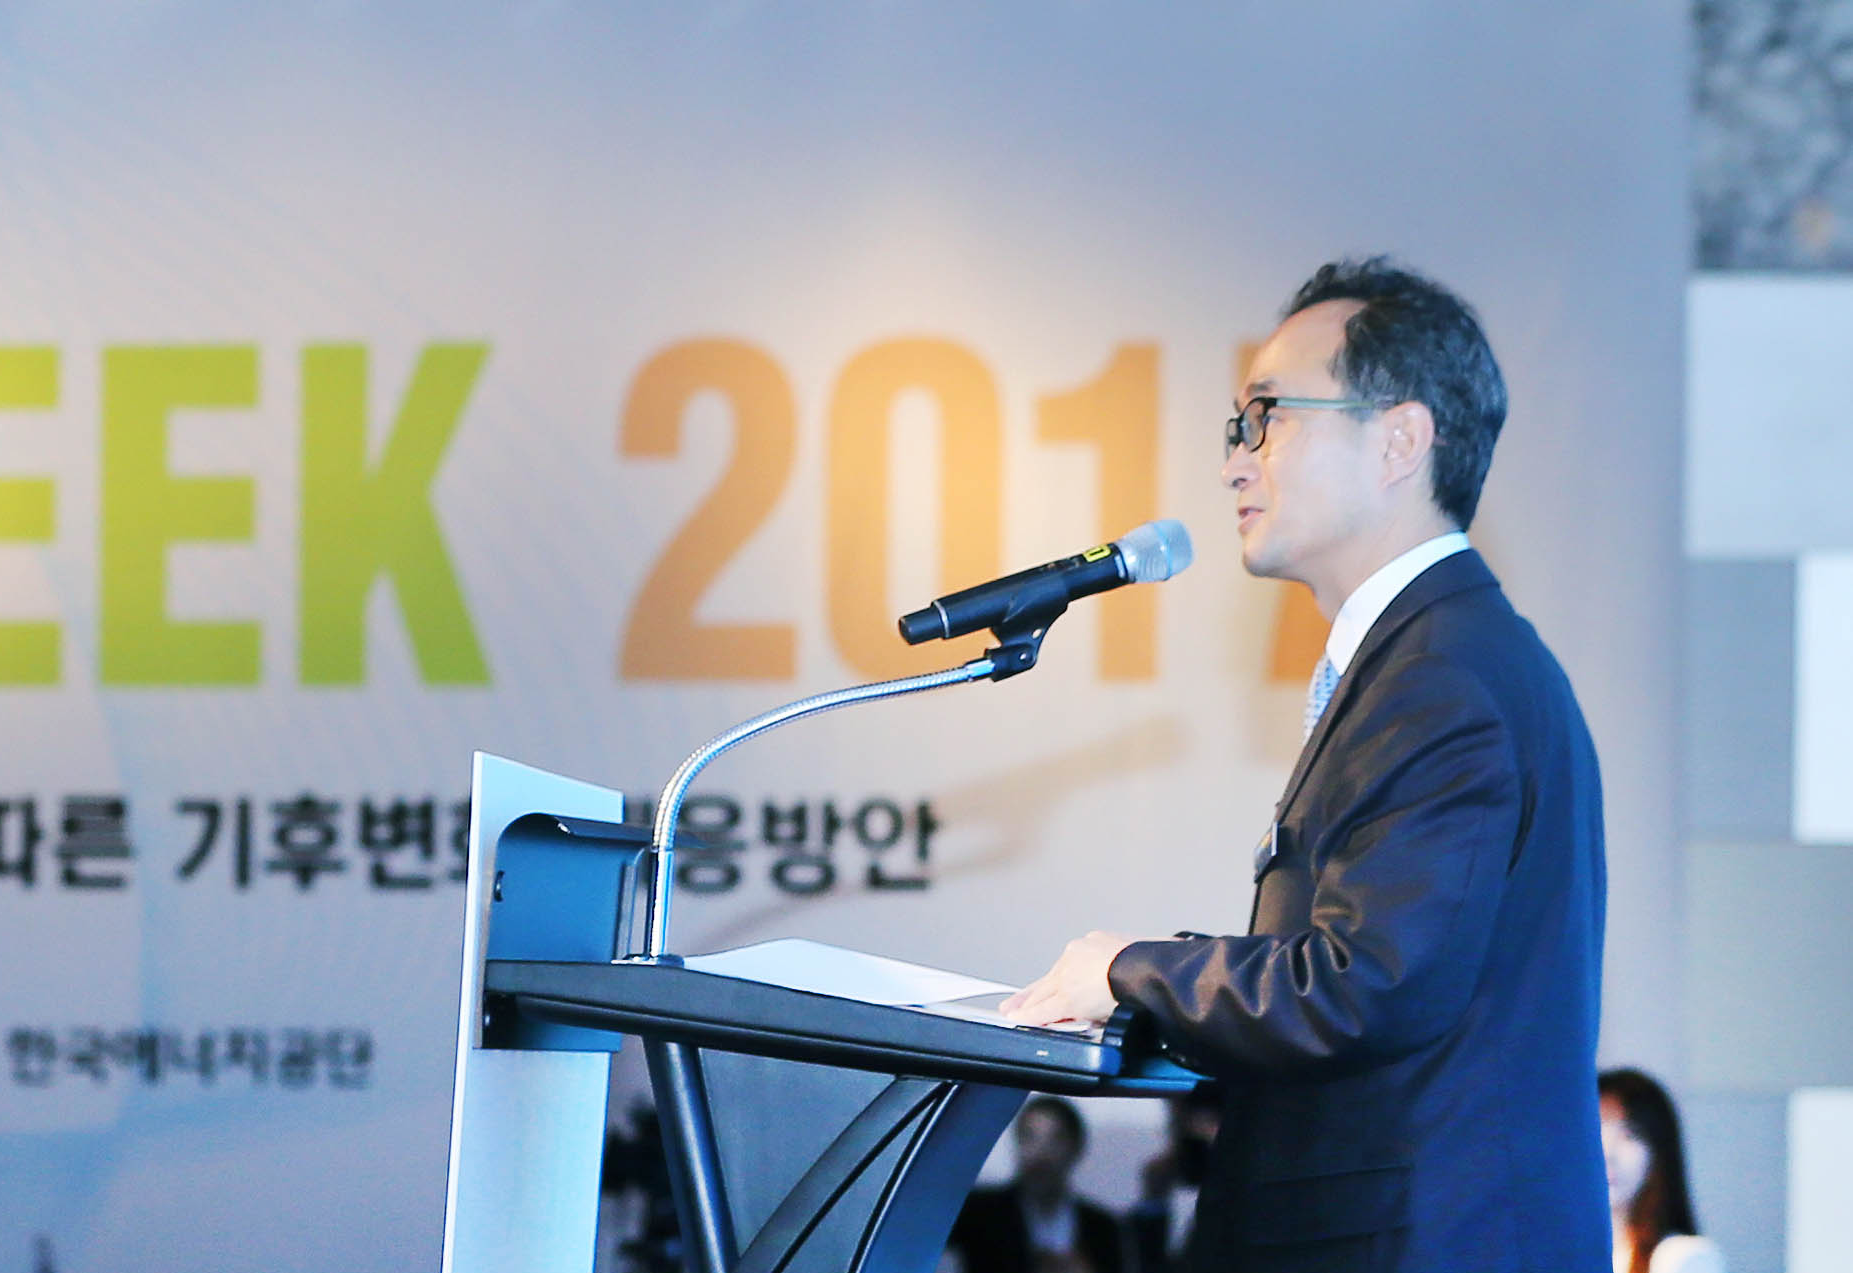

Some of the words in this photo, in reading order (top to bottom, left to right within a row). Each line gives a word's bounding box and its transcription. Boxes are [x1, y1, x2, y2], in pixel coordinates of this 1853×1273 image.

[174, 793, 469, 892] 기후변
[624, 793, 948, 896] 응방안
[6, 1025, 375, 1090] 한국에너지공단
